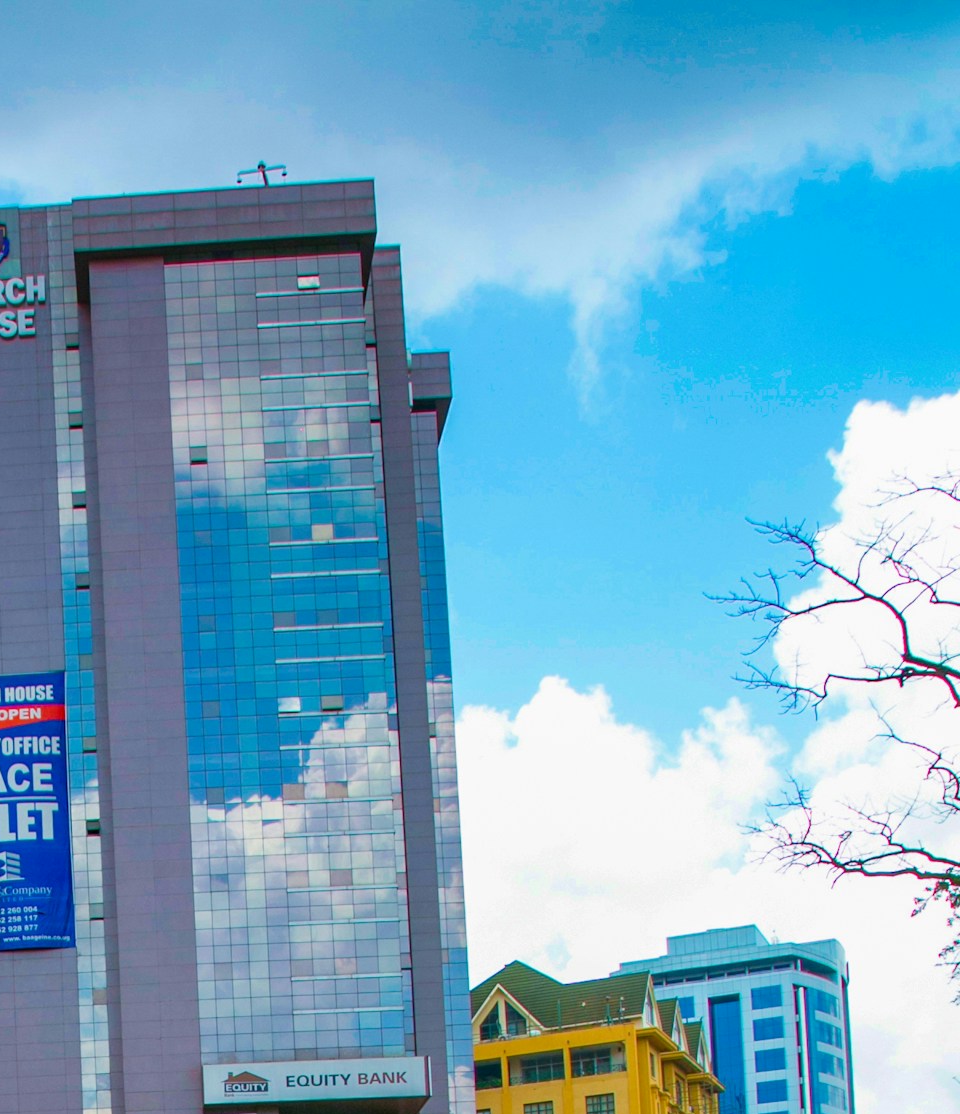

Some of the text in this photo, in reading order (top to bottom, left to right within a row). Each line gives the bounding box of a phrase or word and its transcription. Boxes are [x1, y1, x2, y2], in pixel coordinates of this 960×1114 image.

[4, 684, 54, 702] HOUSE
[23, 905, 38, 913] 004
[24, 914, 38, 922] 117
[7, 925, 22, 933] 928
[24, 923, 38, 931] 877
[286, 1071, 407, 1088] EQUITY BANK
[225, 1083, 267, 1092] EQUITY
